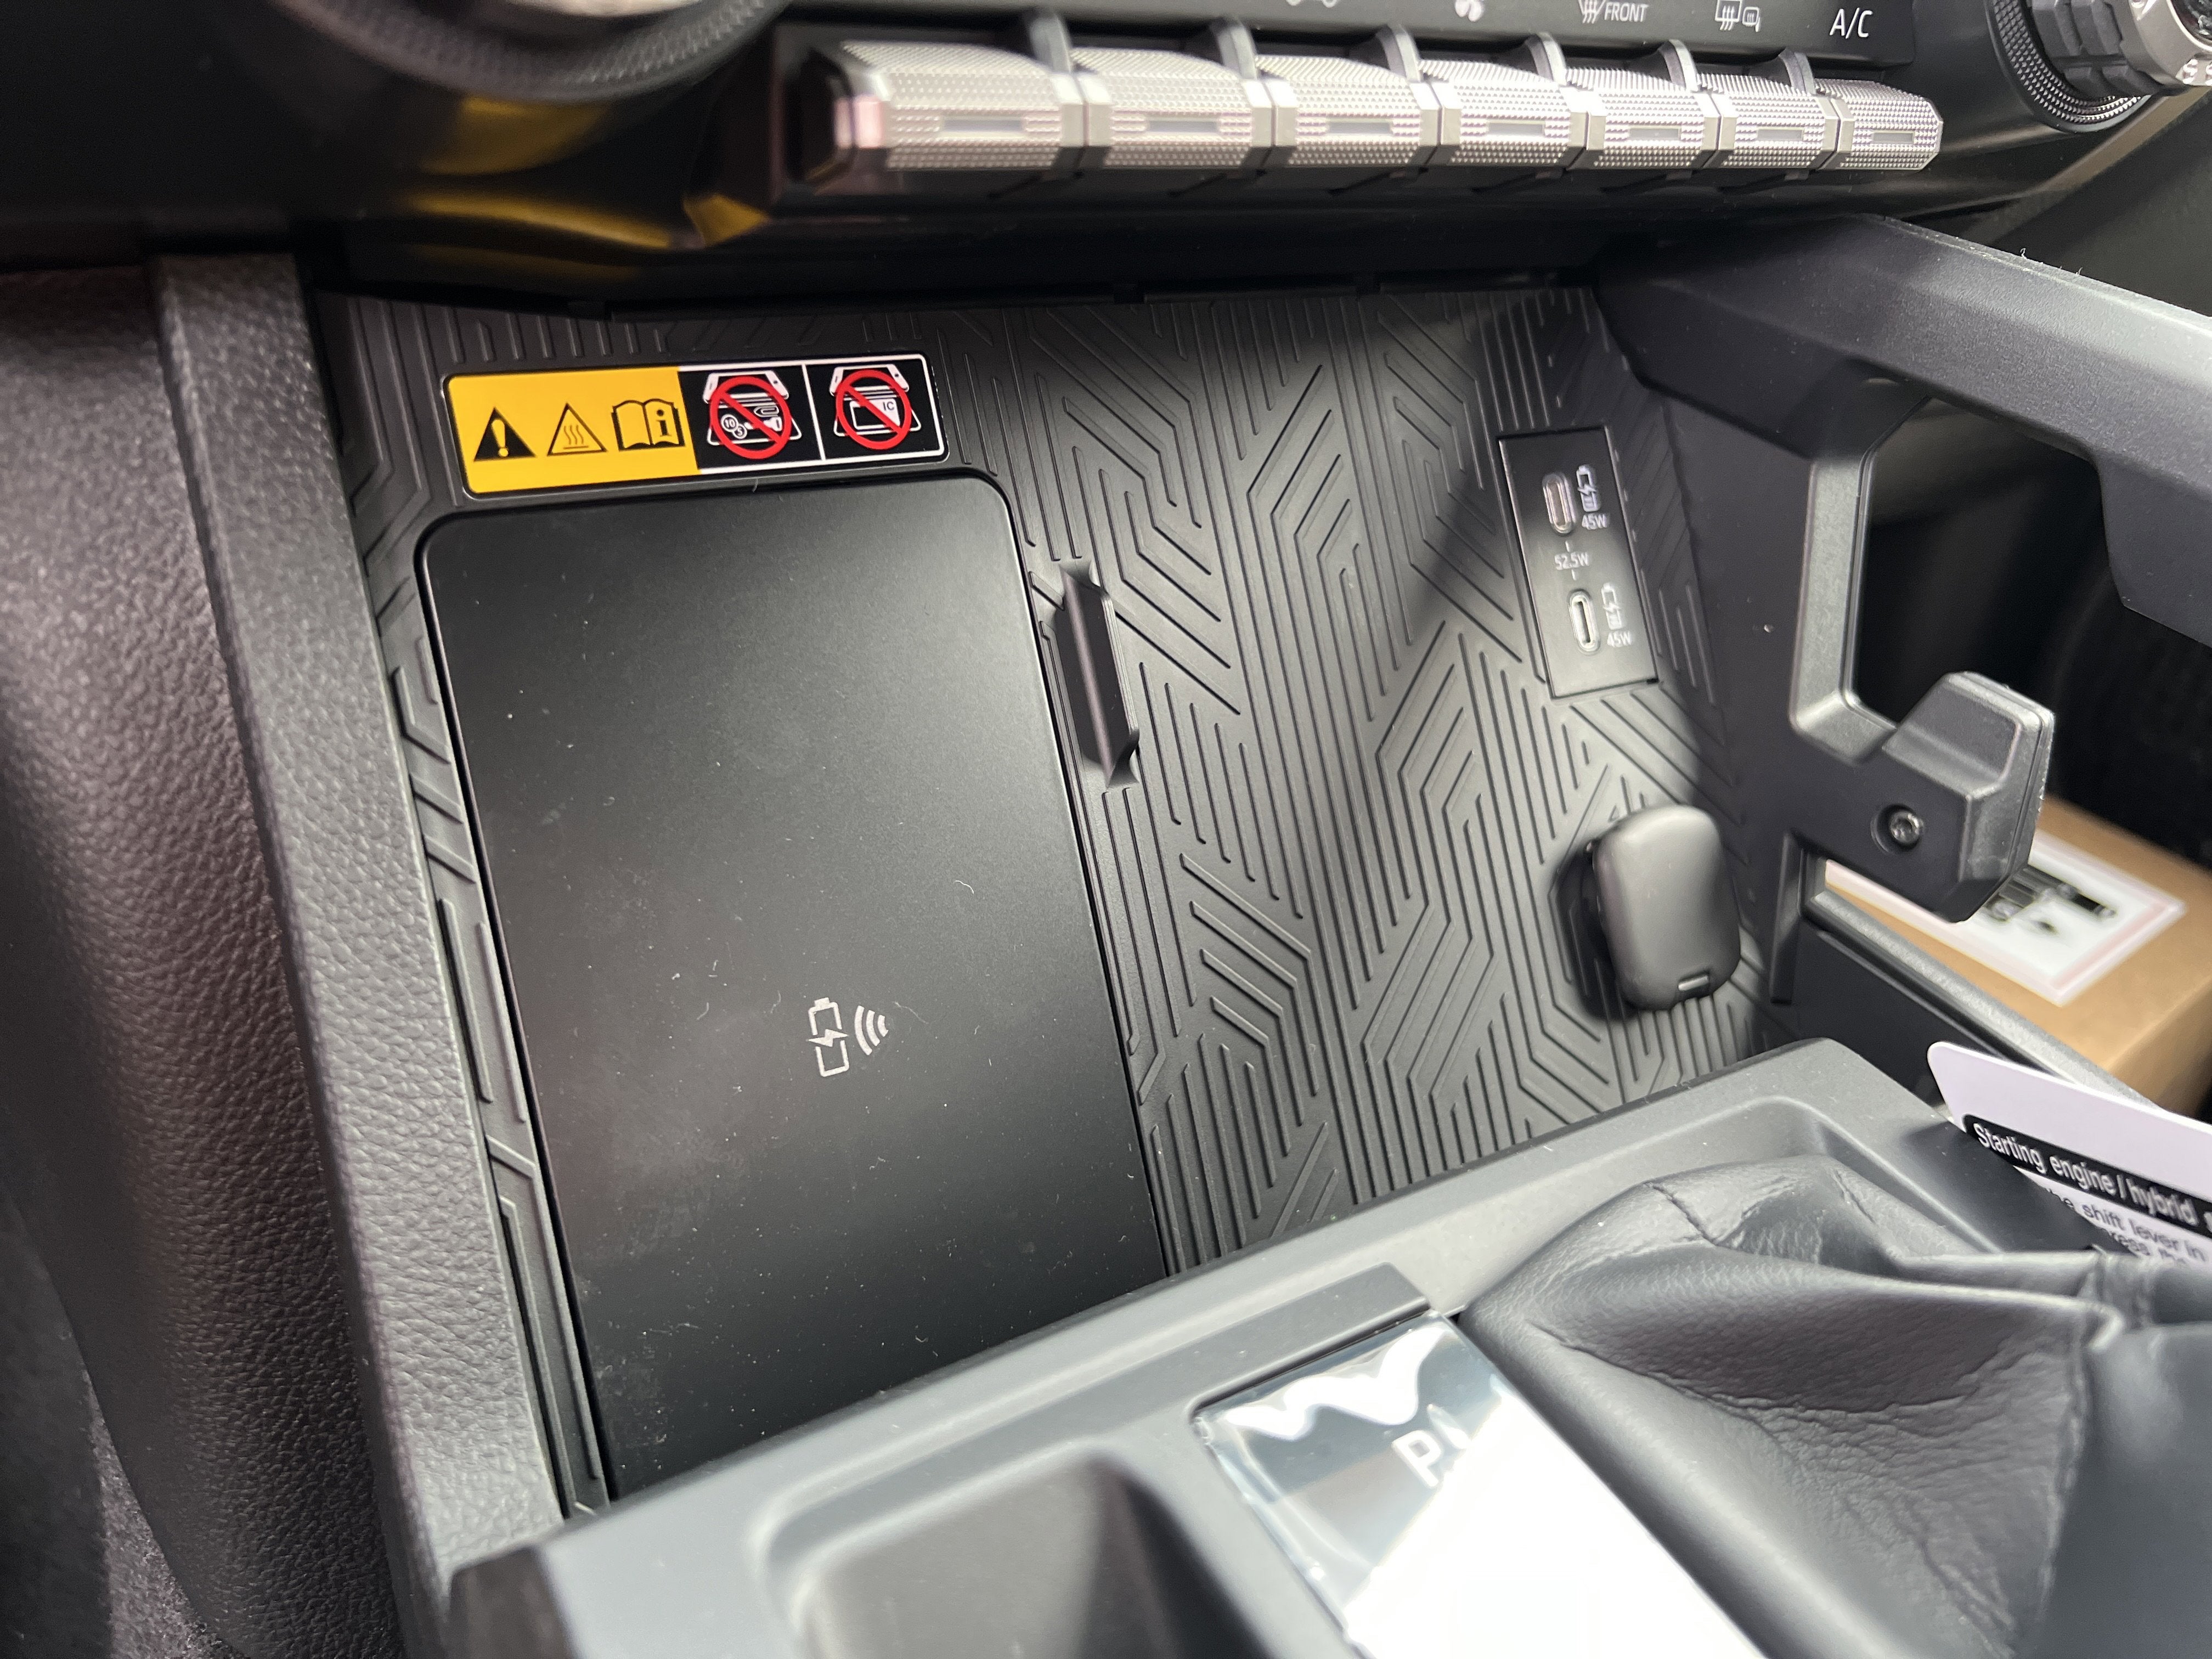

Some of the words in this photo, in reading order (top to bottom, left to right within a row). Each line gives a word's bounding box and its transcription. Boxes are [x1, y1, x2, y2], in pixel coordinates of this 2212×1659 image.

[1604, 2, 1649, 22] FRONT
[1829, 7, 1874, 39] A/C
[883, 401, 895, 411] IC
[725, 417, 736, 428] 10
[1581, 513, 1609, 530] 45W
[1554, 551, 1590, 570] 52.5W
[1607, 631, 1633, 647] 45W
[1973, 1123, 2047, 1174] Starting
[2049, 1155, 2117, 1196] engine
[2126, 1178, 2199, 1227] hybrid
[2082, 1202, 2125, 1231] shift
[2128, 1217, 2179, 1251] lever
